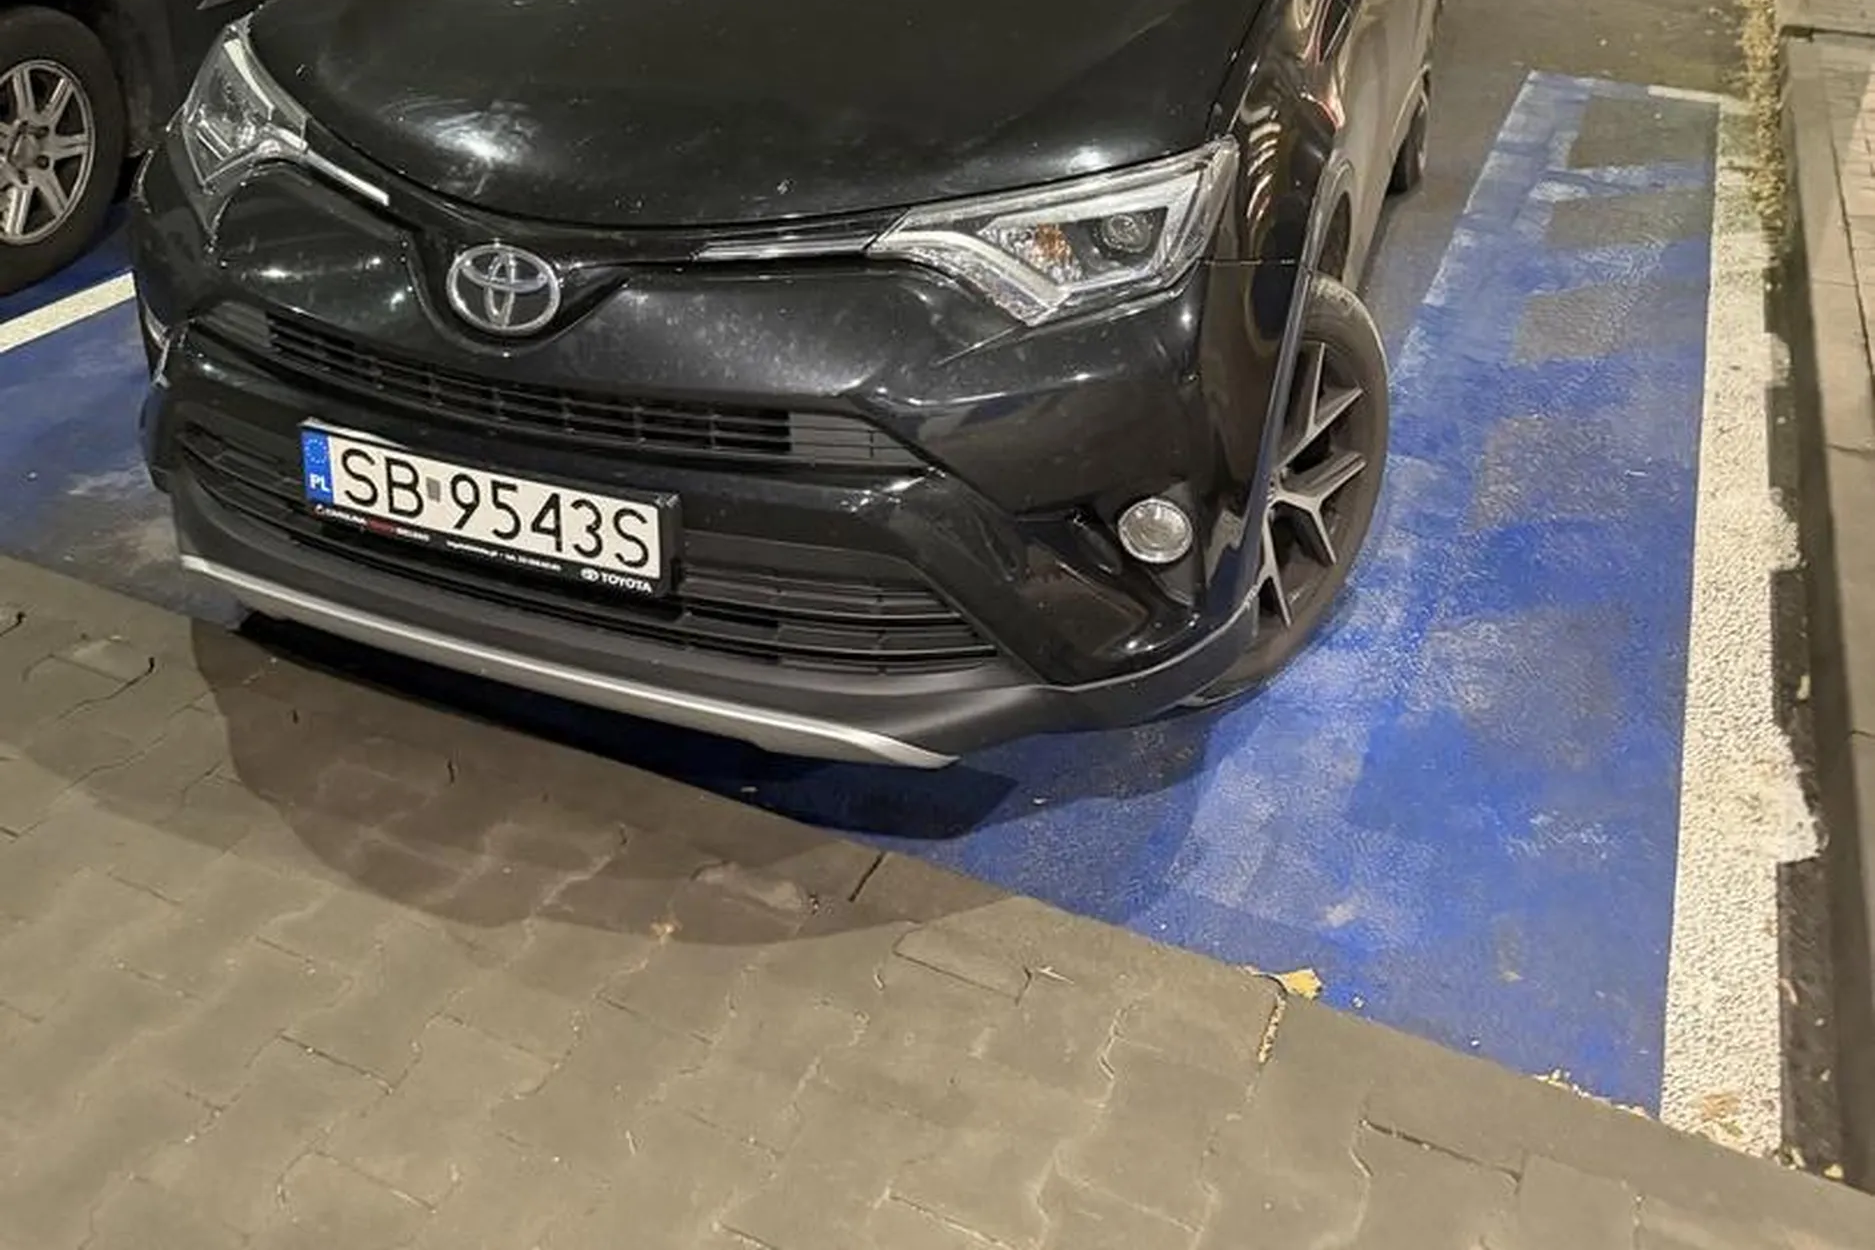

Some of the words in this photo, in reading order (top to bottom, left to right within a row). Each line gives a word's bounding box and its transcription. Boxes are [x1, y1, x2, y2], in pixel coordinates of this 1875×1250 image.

[309, 472, 332, 493] PL
[341, 448, 425, 519] SB
[449, 472, 651, 569] 9543S
[601, 572, 653, 594] TOYOTA
